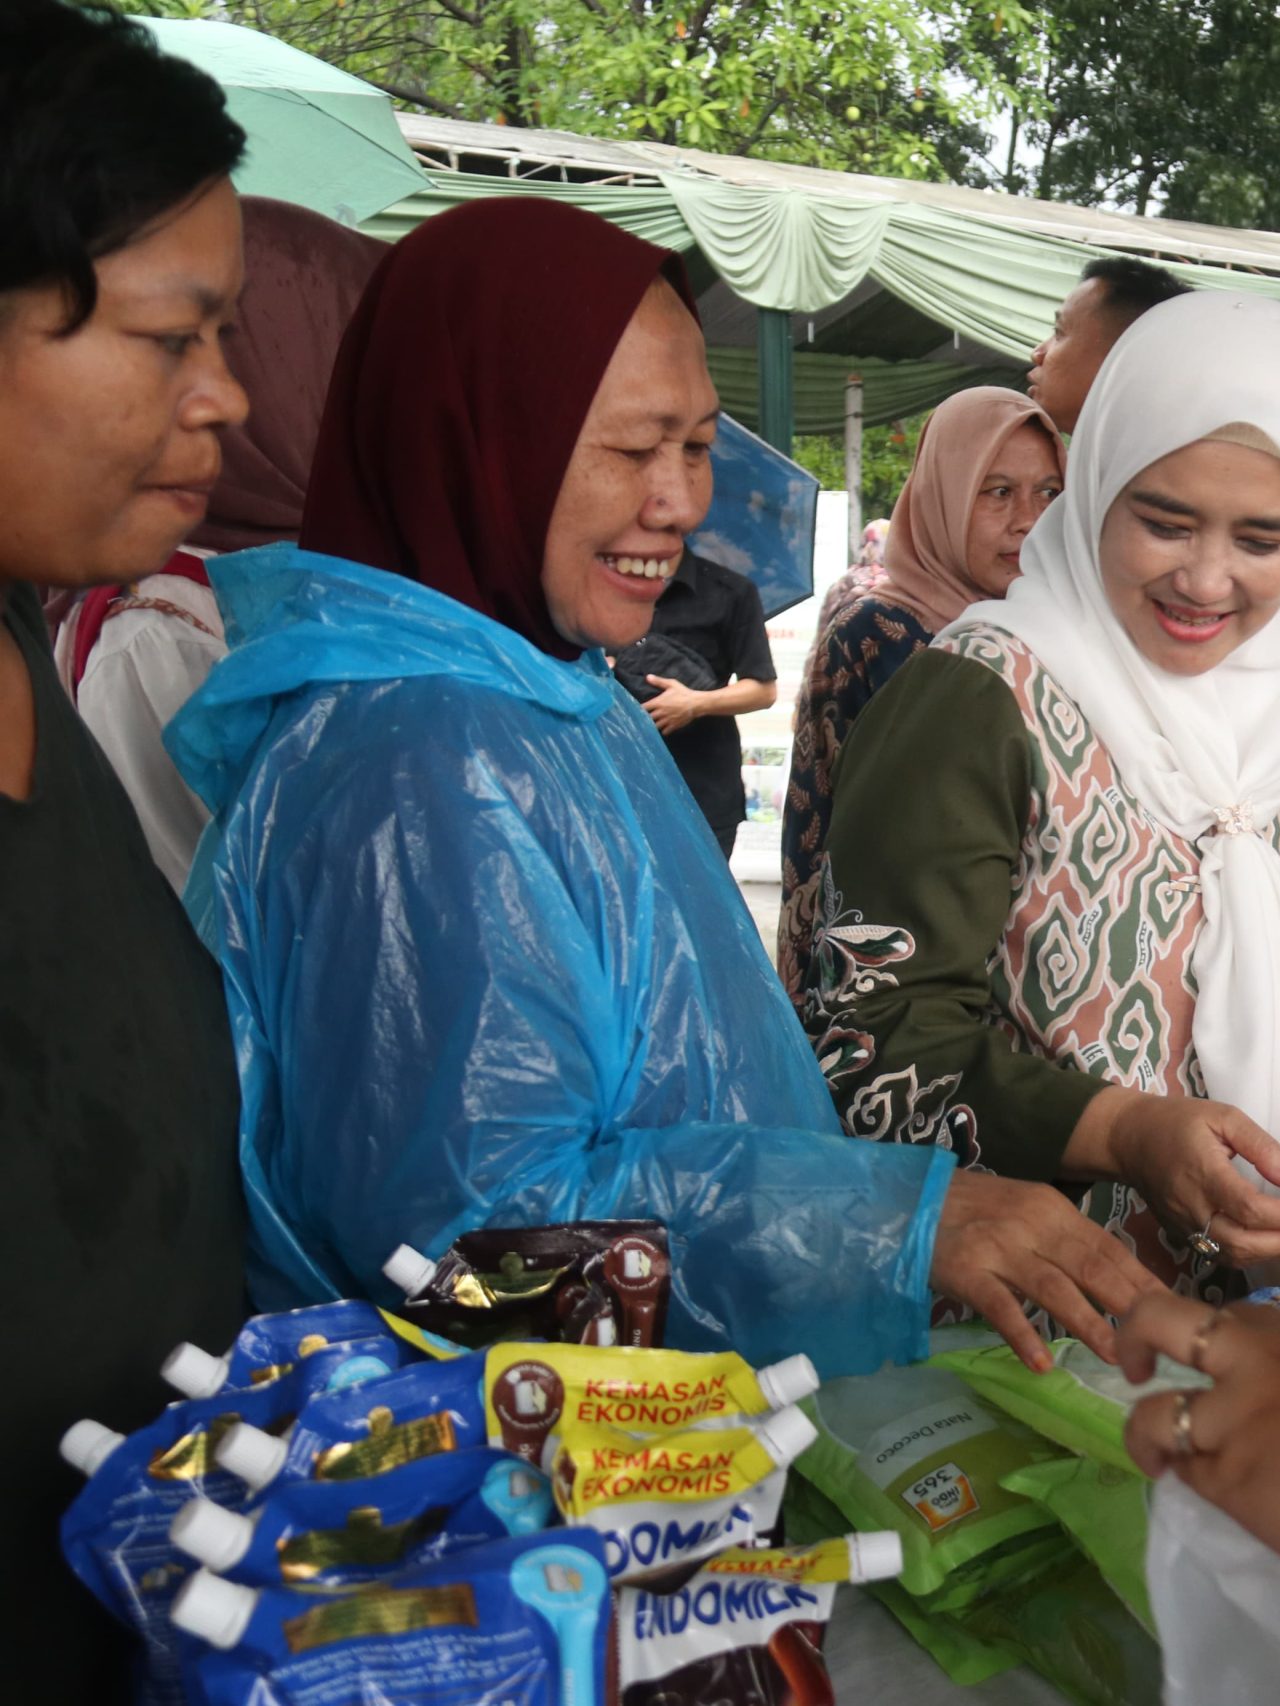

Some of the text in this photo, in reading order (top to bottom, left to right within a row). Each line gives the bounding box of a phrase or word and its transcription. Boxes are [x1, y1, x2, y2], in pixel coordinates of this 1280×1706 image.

[585, 1373, 727, 1404] KEMASAN
[576, 1392, 727, 1426] EKONOMIS
[876, 1411, 974, 1464] Nata Decoco
[591, 1447, 736, 1473] KEMASAN
[581, 1469, 732, 1502] EKONOMIS
[912, 1469, 954, 1498] 365
[930, 1485, 961, 1507] INDO
